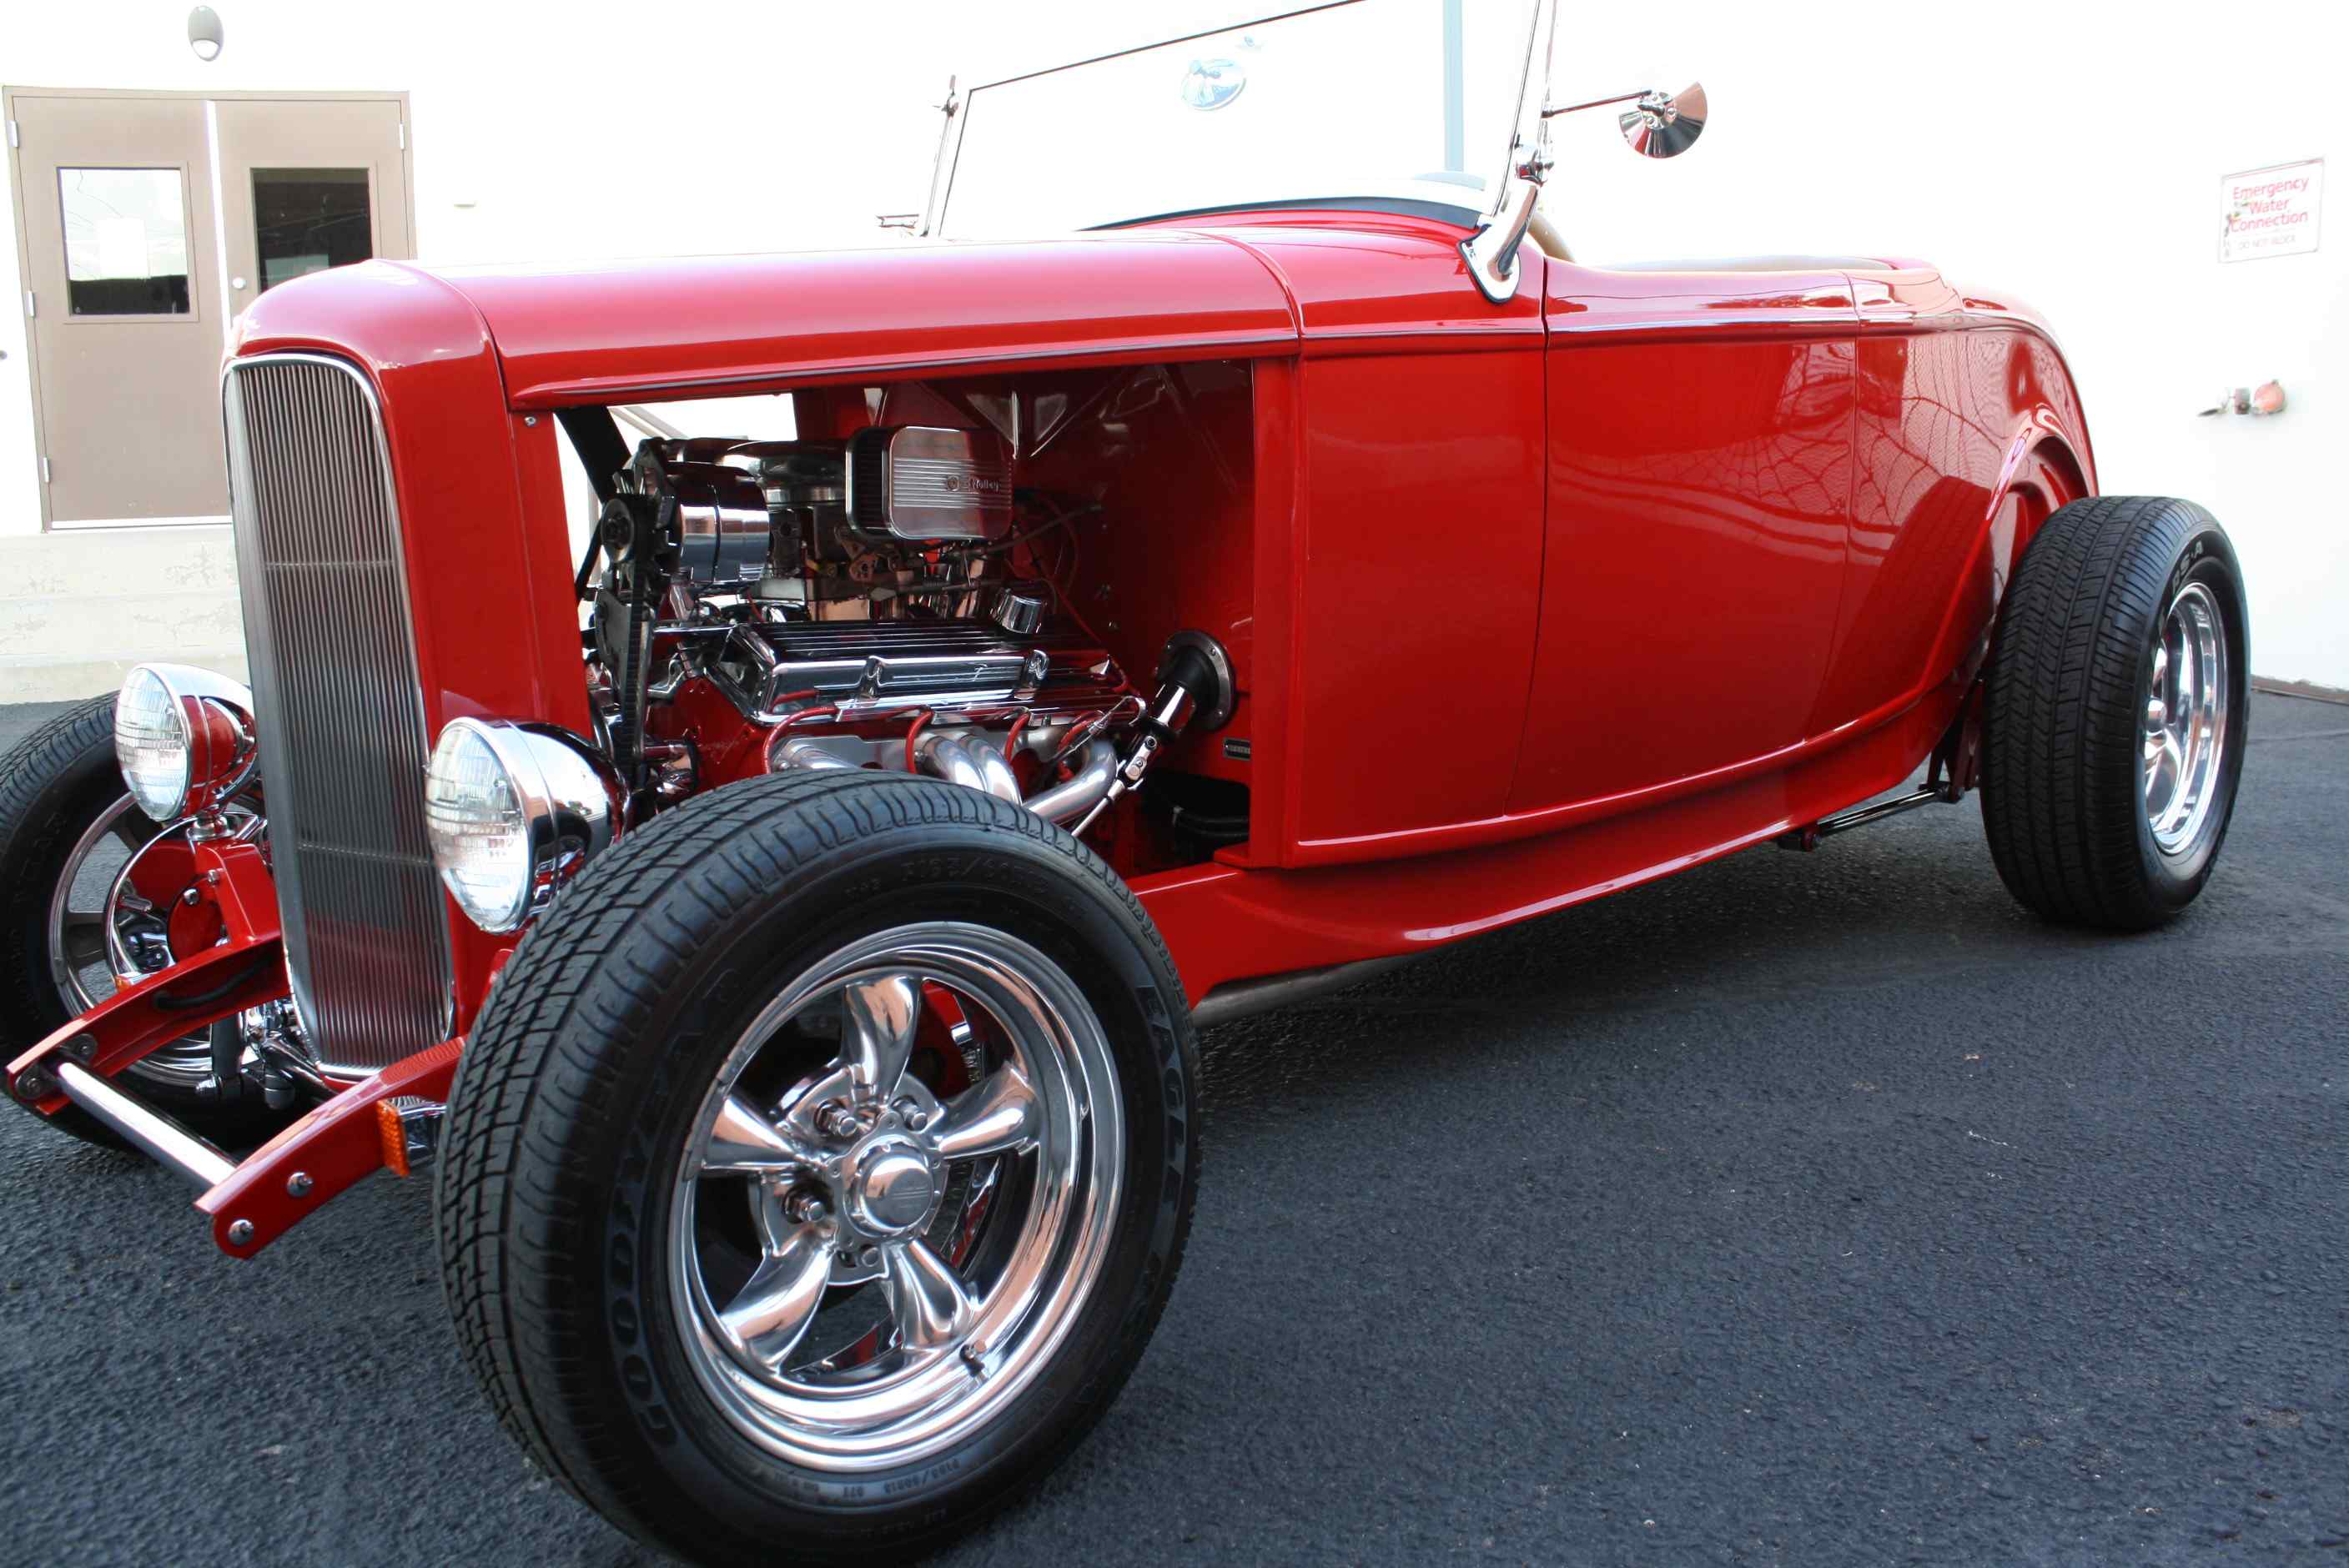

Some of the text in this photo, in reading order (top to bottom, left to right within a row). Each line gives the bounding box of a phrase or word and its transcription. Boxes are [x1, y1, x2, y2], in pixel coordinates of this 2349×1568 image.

[2232, 178, 2310, 199] Emergency
[2248, 198, 2291, 215] Water
[2230, 211, 2308, 233] Connection
[972, 479, 1002, 493] Holley
[1133, 986, 1185, 1204] EAGLE
[611, 966, 746, 1450] GOODYEAR
